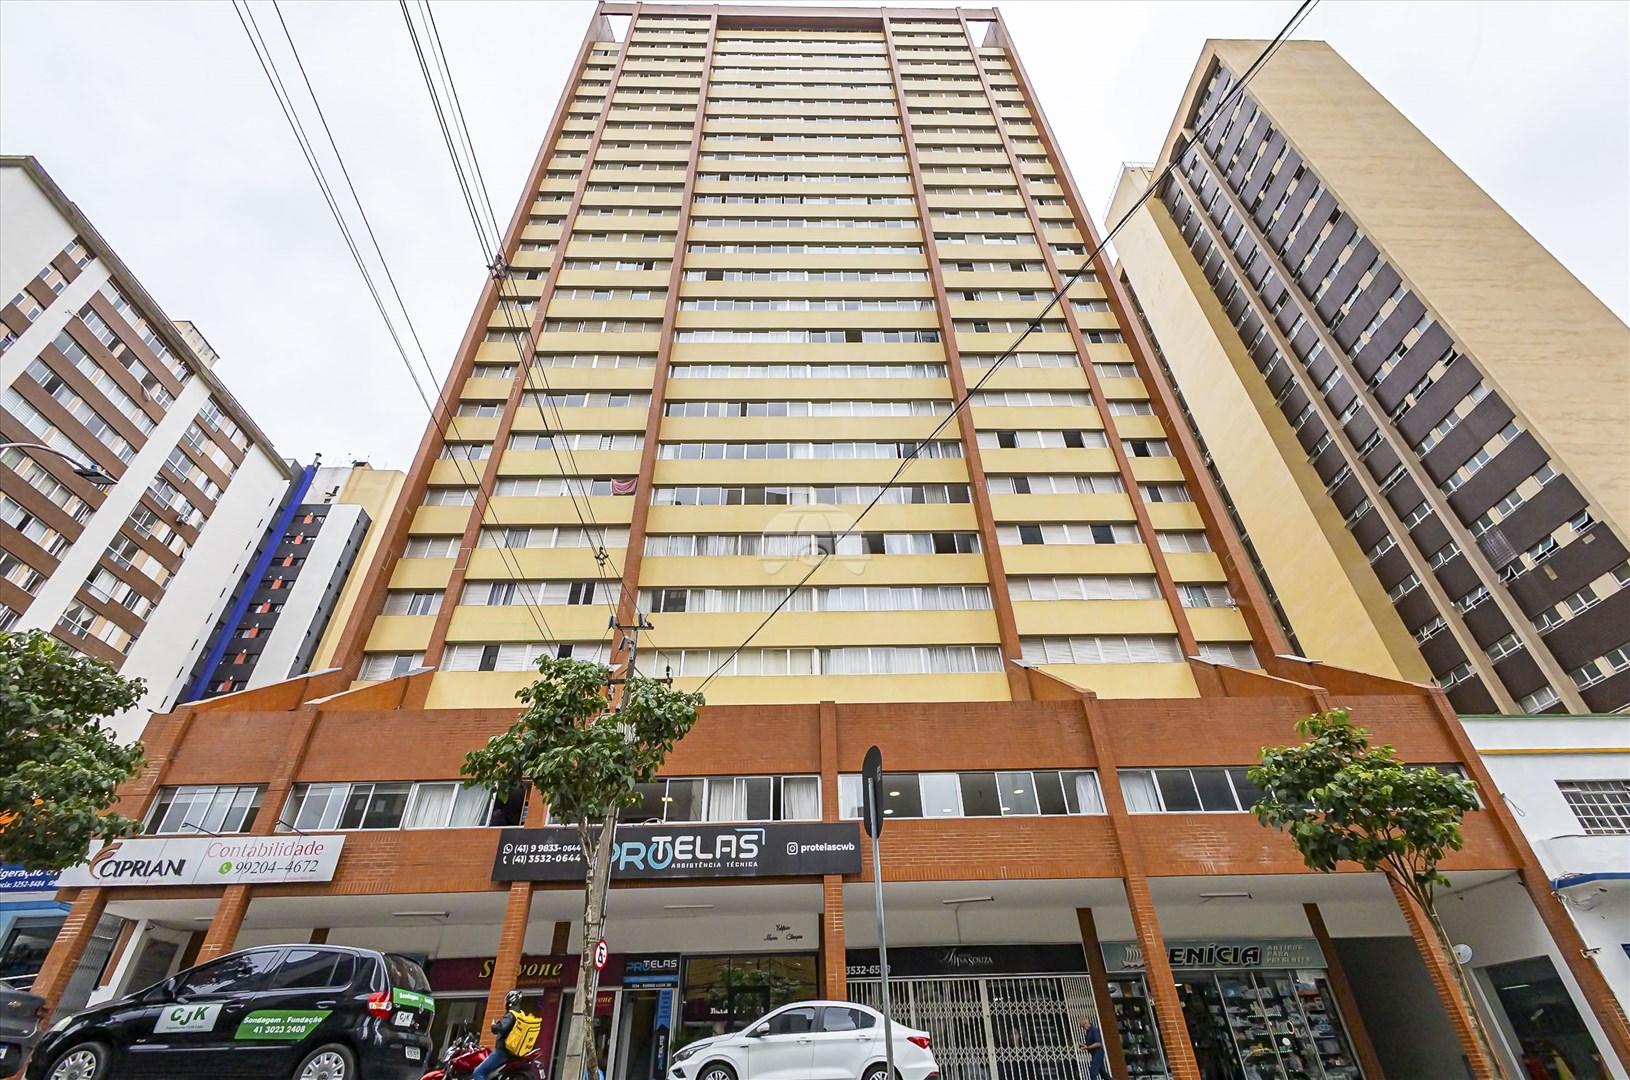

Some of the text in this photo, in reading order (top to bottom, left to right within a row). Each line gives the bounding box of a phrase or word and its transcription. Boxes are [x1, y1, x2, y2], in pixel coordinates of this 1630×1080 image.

[207, 841, 324, 858] Contabilidade
[514, 844, 529, 853] (41)
[530, 844, 536, 852] 9
[801, 842, 855, 854] protelascwb
[512, 854, 581, 865] (41) 3532-0644
[671, 860, 758, 869] ASSISTÊNCIA TÉCNICA
[100, 859, 186, 877] CIPRIANI
[234, 860, 319, 874] 99204-4672
[1168, 944, 1261, 967] ENÍCIA
[626, 959, 678, 972] PROTELAS
[846, 965, 891, 976] 3532-658
[243, 1016, 323, 1025] Sondagem Fundação
[253, 1026, 262, 1034] 41
[265, 1026, 284, 1034] 3023
